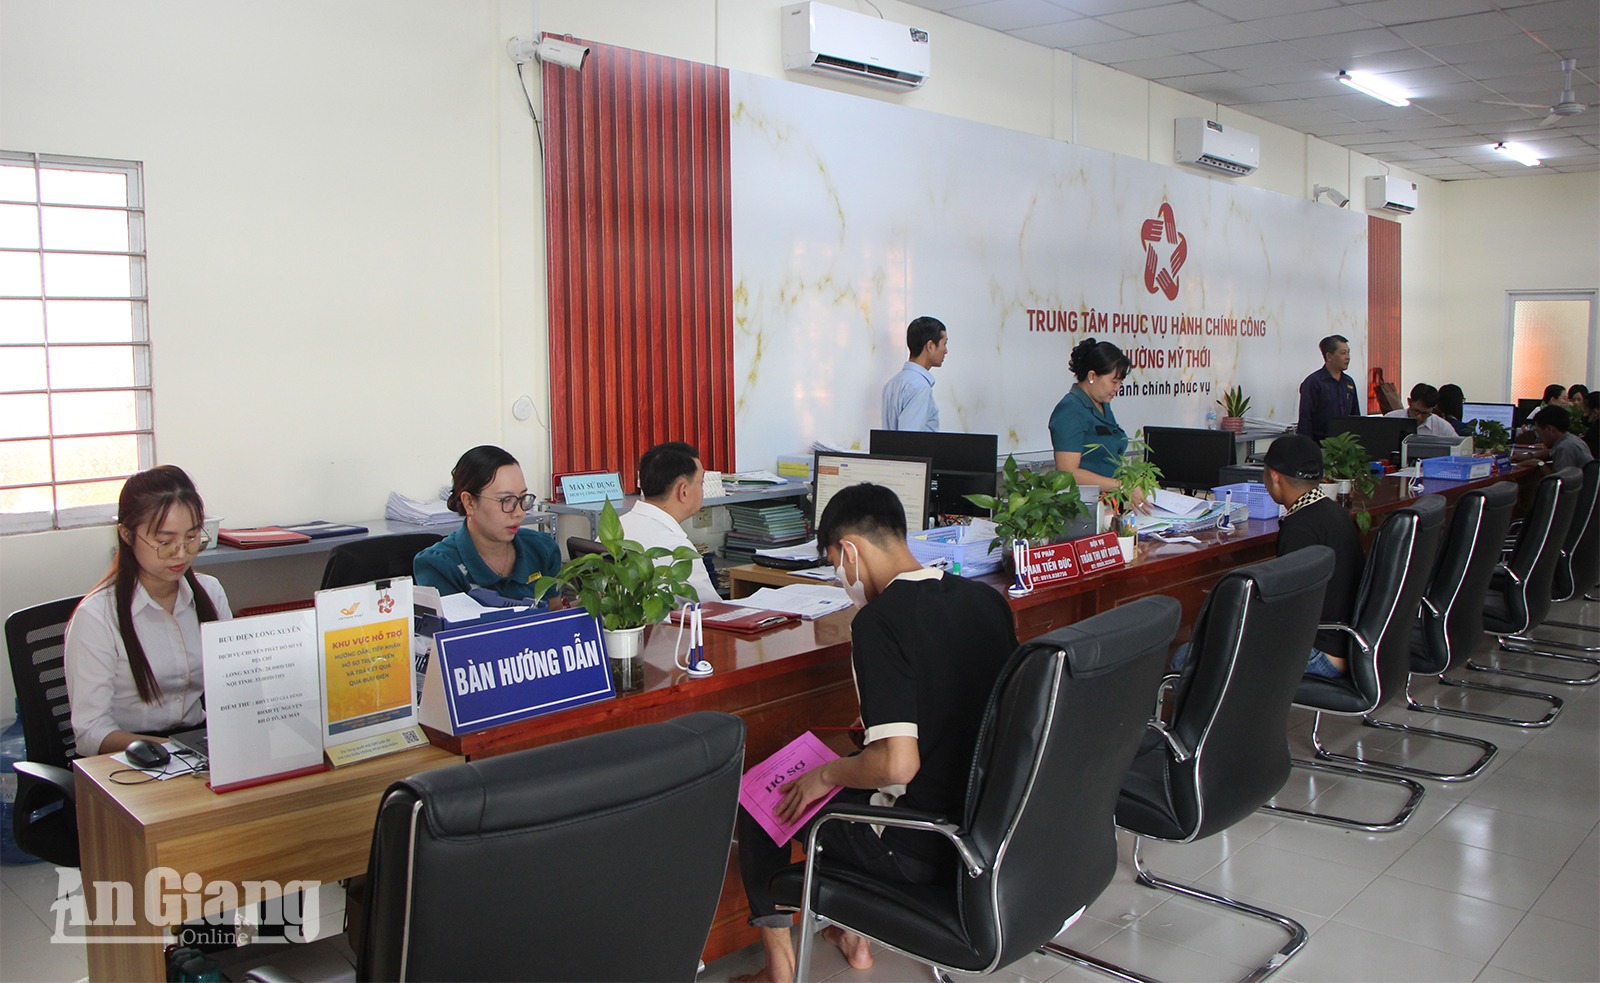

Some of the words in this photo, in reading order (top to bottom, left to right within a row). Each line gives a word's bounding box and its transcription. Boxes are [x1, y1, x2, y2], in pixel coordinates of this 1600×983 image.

[1027, 309, 1078, 332] TRUNG
[1081, 308, 1108, 333] TÂM
[1113, 313, 1148, 339] PHỤC
[1152, 315, 1167, 339] VỤ
[1171, 312, 1202, 335] HÀNH
[1205, 313, 1237, 337] CHÍNH
[1240, 315, 1266, 337] CÔNG
[1121, 345, 1164, 369] ƯỜNG
[1168, 346, 1184, 368] MỸ
[1186, 346, 1211, 368] THỚI
[1116, 381, 1139, 397] ành
[1142, 380, 1171, 396] chính
[1174, 380, 1198, 397] phục
[1200, 382, 1211, 395] vụ
[569, 482, 586, 491] MÁY
[596, 480, 616, 489] DỤNG
[1041, 557, 1058, 572] TIẾN
[1057, 556, 1073, 570] ĐỨC
[255, 629, 276, 638] LONG
[332, 640, 350, 649] KHU
[352, 635, 370, 645] VỰC
[371, 631, 384, 641] HỖ
[386, 628, 403, 639] TRỢ
[453, 659, 496, 697] BÀN
[498, 647, 560, 687] HƯỚNG
[563, 633, 600, 673] DẪN
[349, 679, 361, 687] QUA
[764, 774, 785, 793] HỒ
[786, 760, 806, 776] SƠ
